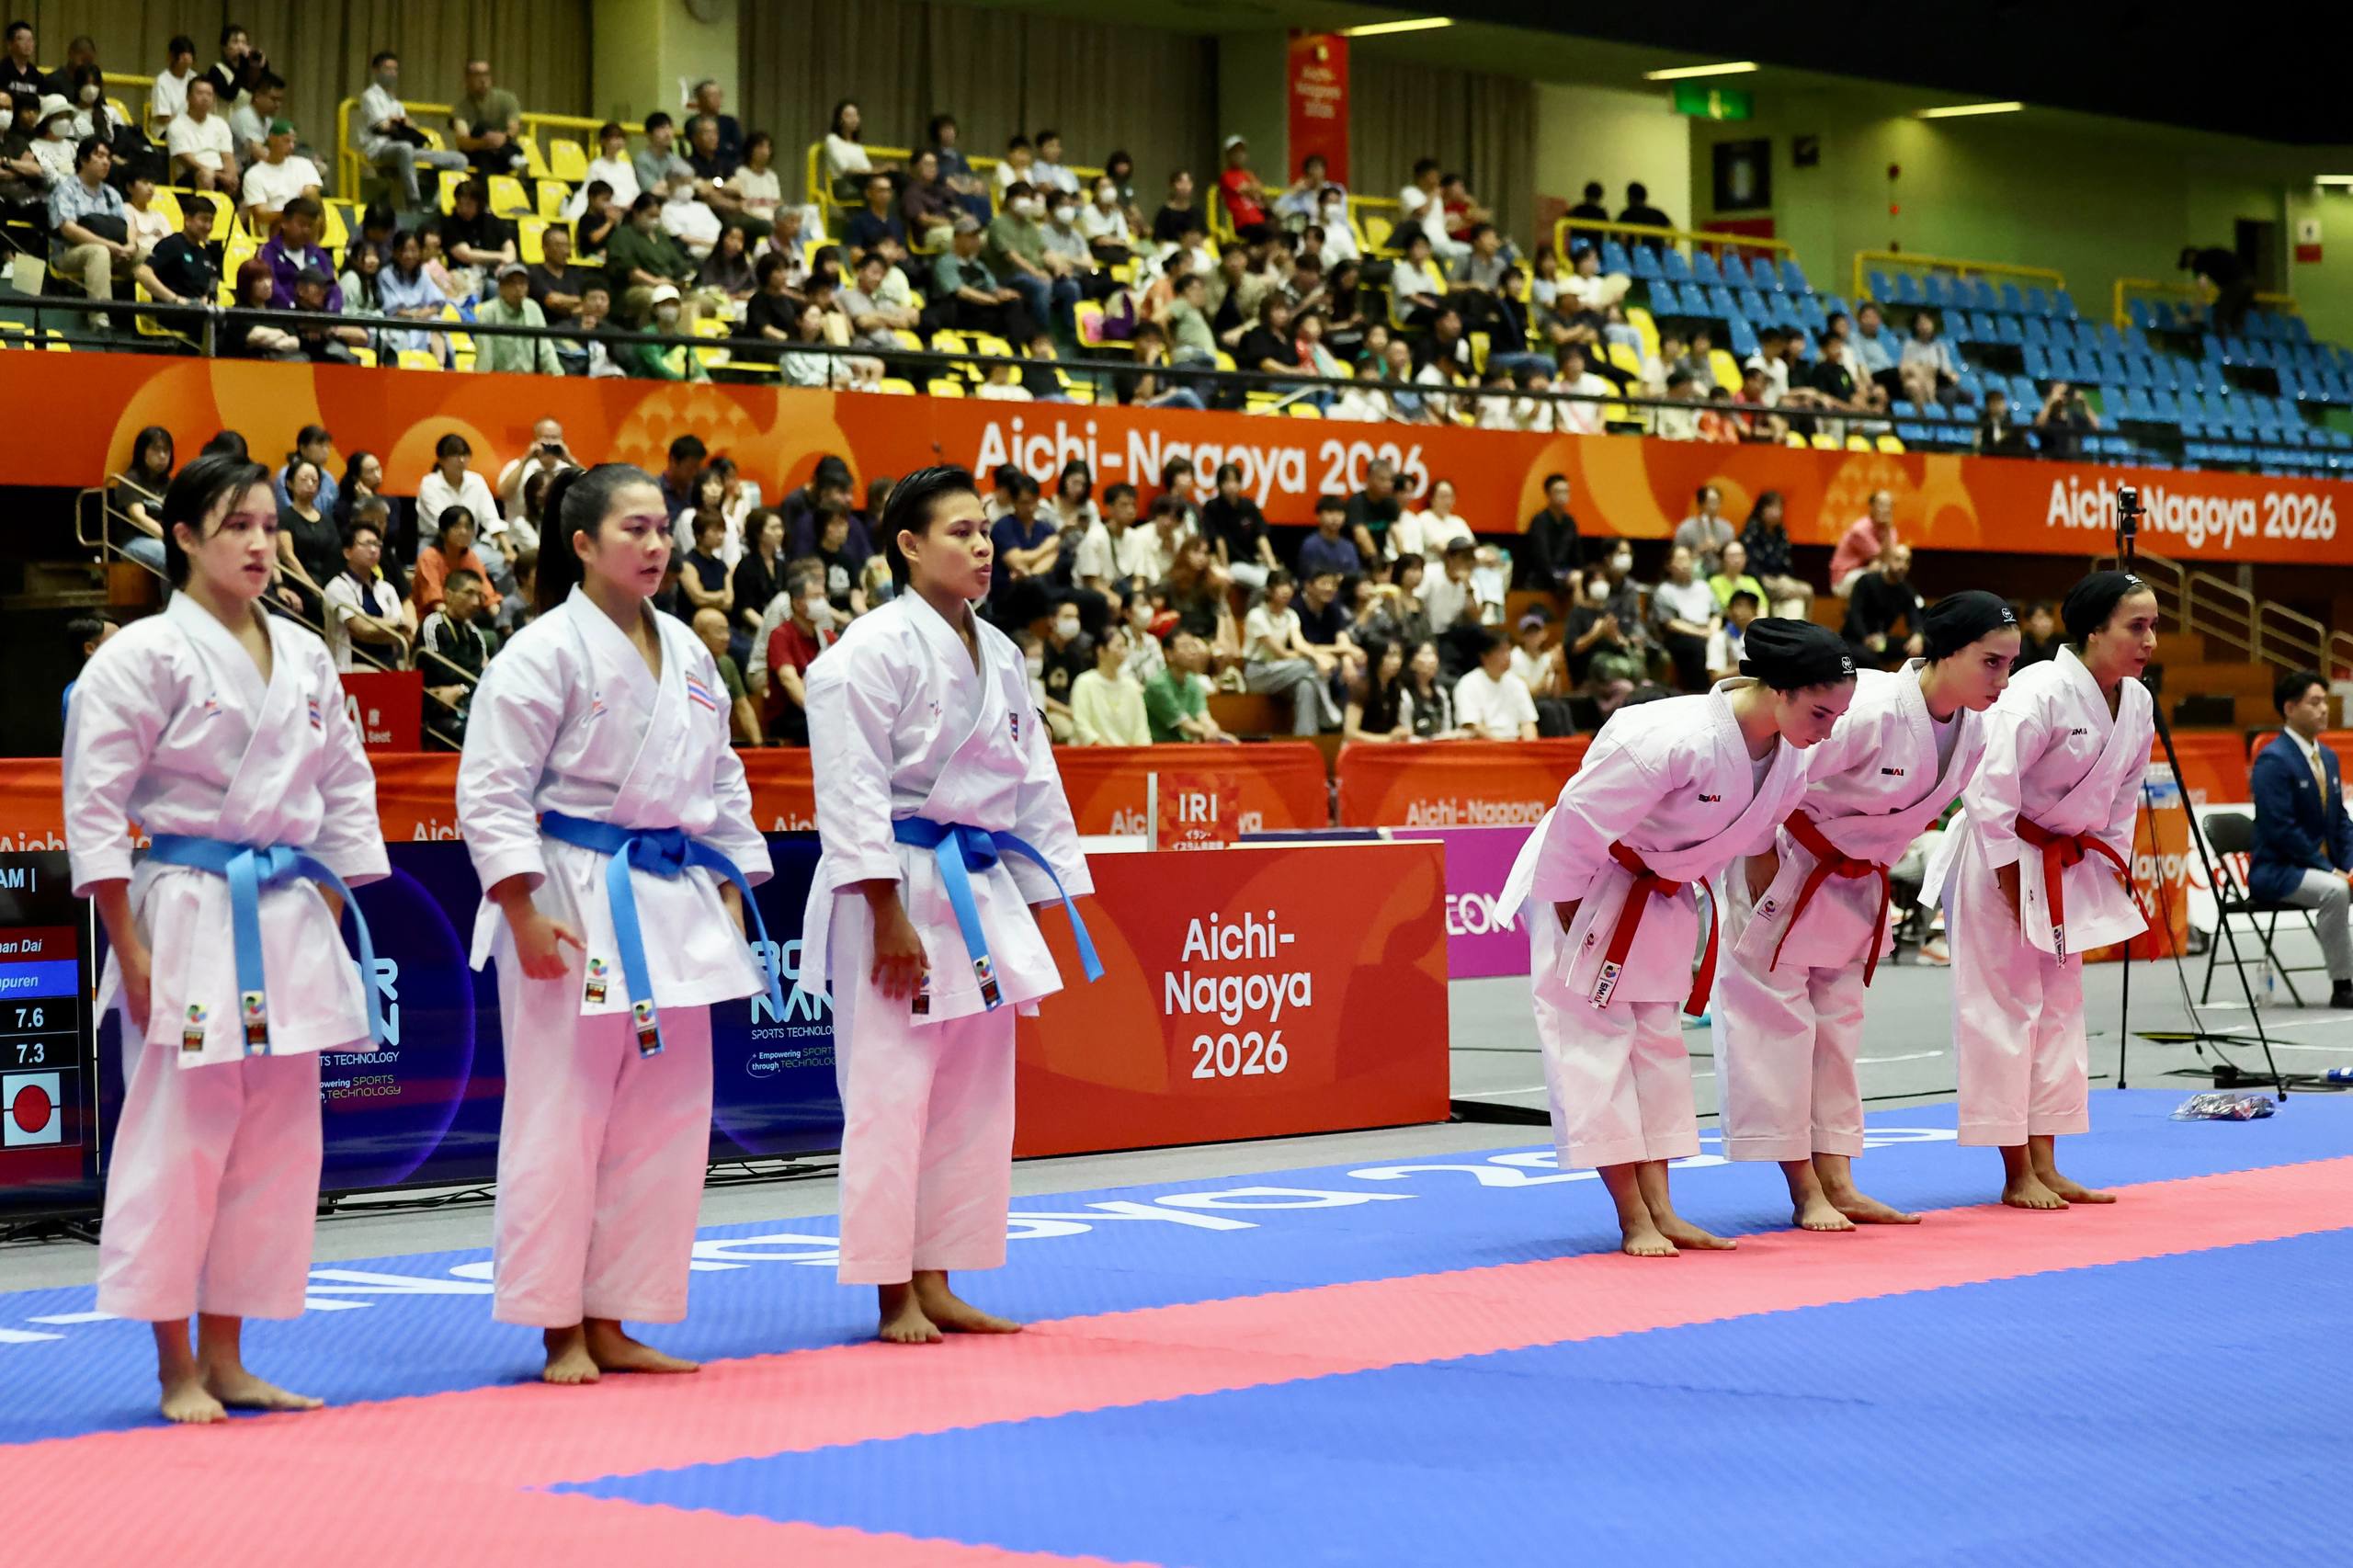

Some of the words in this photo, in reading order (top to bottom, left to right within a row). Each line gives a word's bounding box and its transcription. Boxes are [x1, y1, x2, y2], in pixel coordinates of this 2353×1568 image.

[2263, 491, 2337, 541] 2026
[1178, 793, 1218, 823] IRI
[21, 938, 42, 953] Dai
[1181, 909, 1295, 961] Aichi-
[1165, 970, 1313, 1027] Nagoya
[15, 1007, 44, 1028] 7.6
[751, 1028, 785, 1040] SPORTS
[16, 1043, 45, 1064] 7.3
[334, 1051, 400, 1066] TECHNOLOGY
[758, 1050, 801, 1060] Empowering
[1191, 1029, 1288, 1079] 2026
[752, 1062, 779, 1072] through
[352, 1074, 394, 1087] SPORTS
